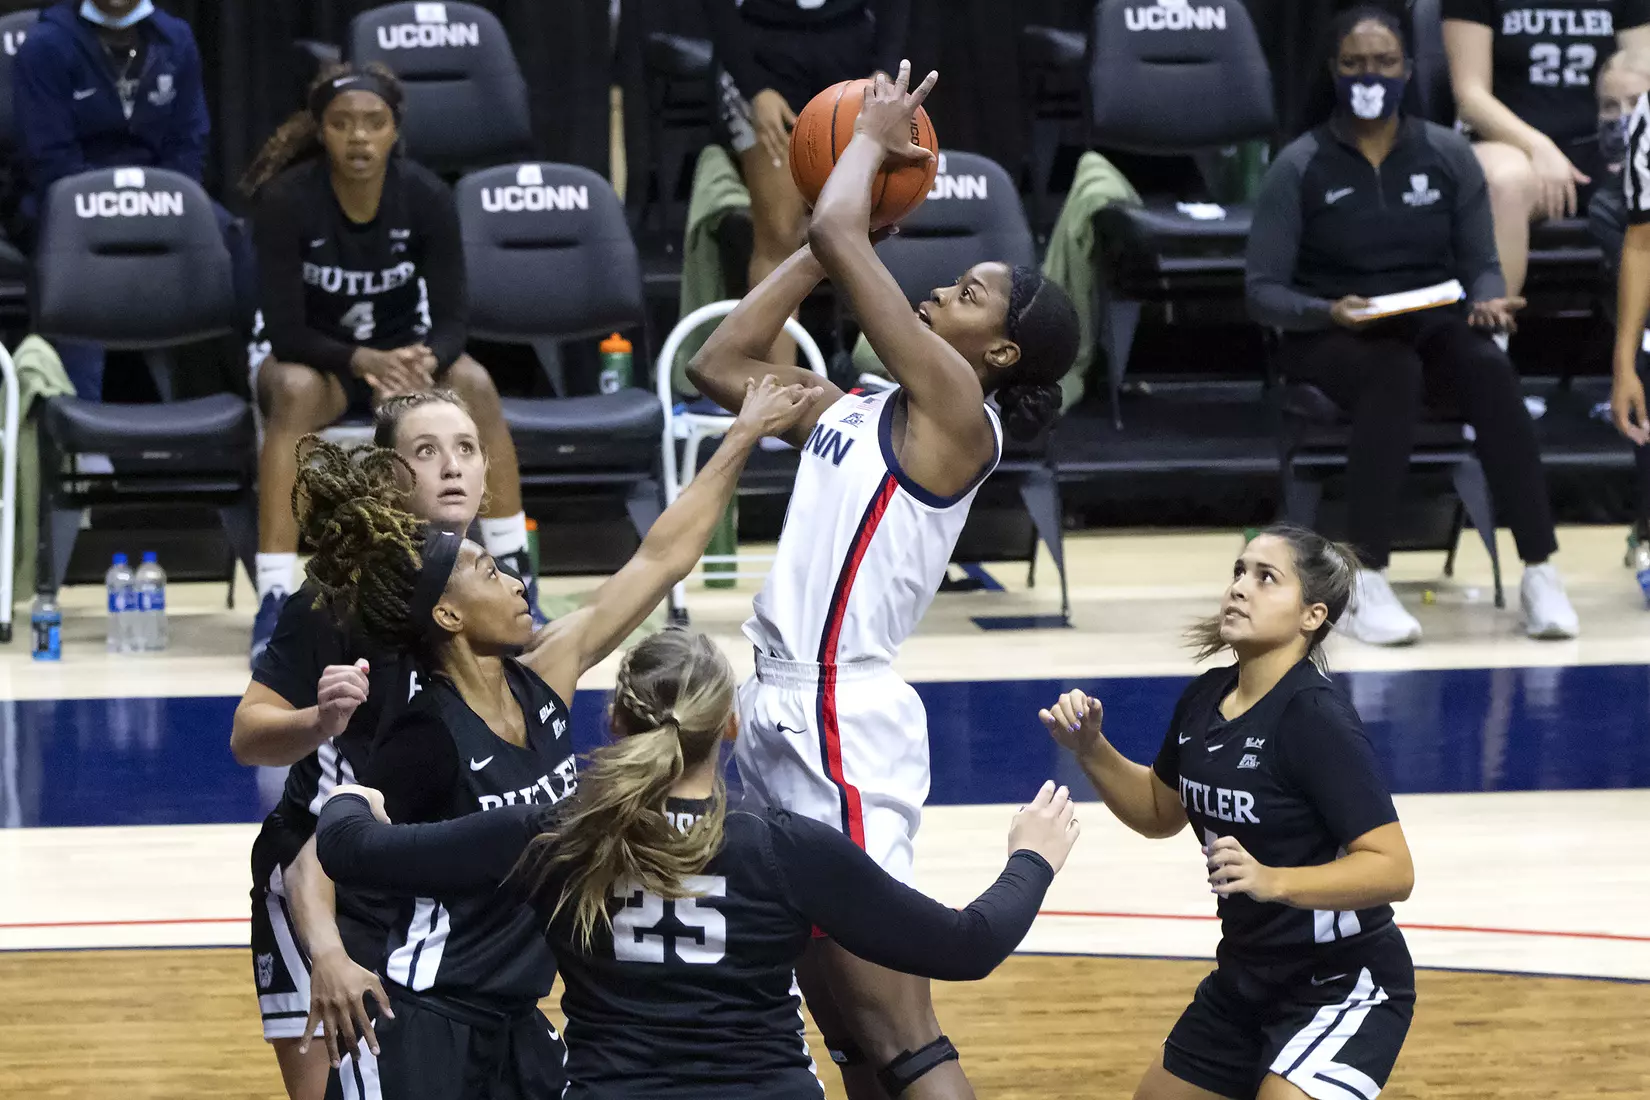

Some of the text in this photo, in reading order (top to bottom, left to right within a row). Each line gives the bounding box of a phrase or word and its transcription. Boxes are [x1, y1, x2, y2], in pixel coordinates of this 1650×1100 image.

[1124, 6, 1226, 31] UCONN
[1502, 8, 1614, 36] BUTLER
[377, 22, 480, 49] UCONN
[1528, 43, 1597, 86] 22
[75, 191, 184, 218] UCONN
[480, 185, 589, 212] UCONN
[340, 301, 376, 340] 4
[613, 871, 727, 964] 25
